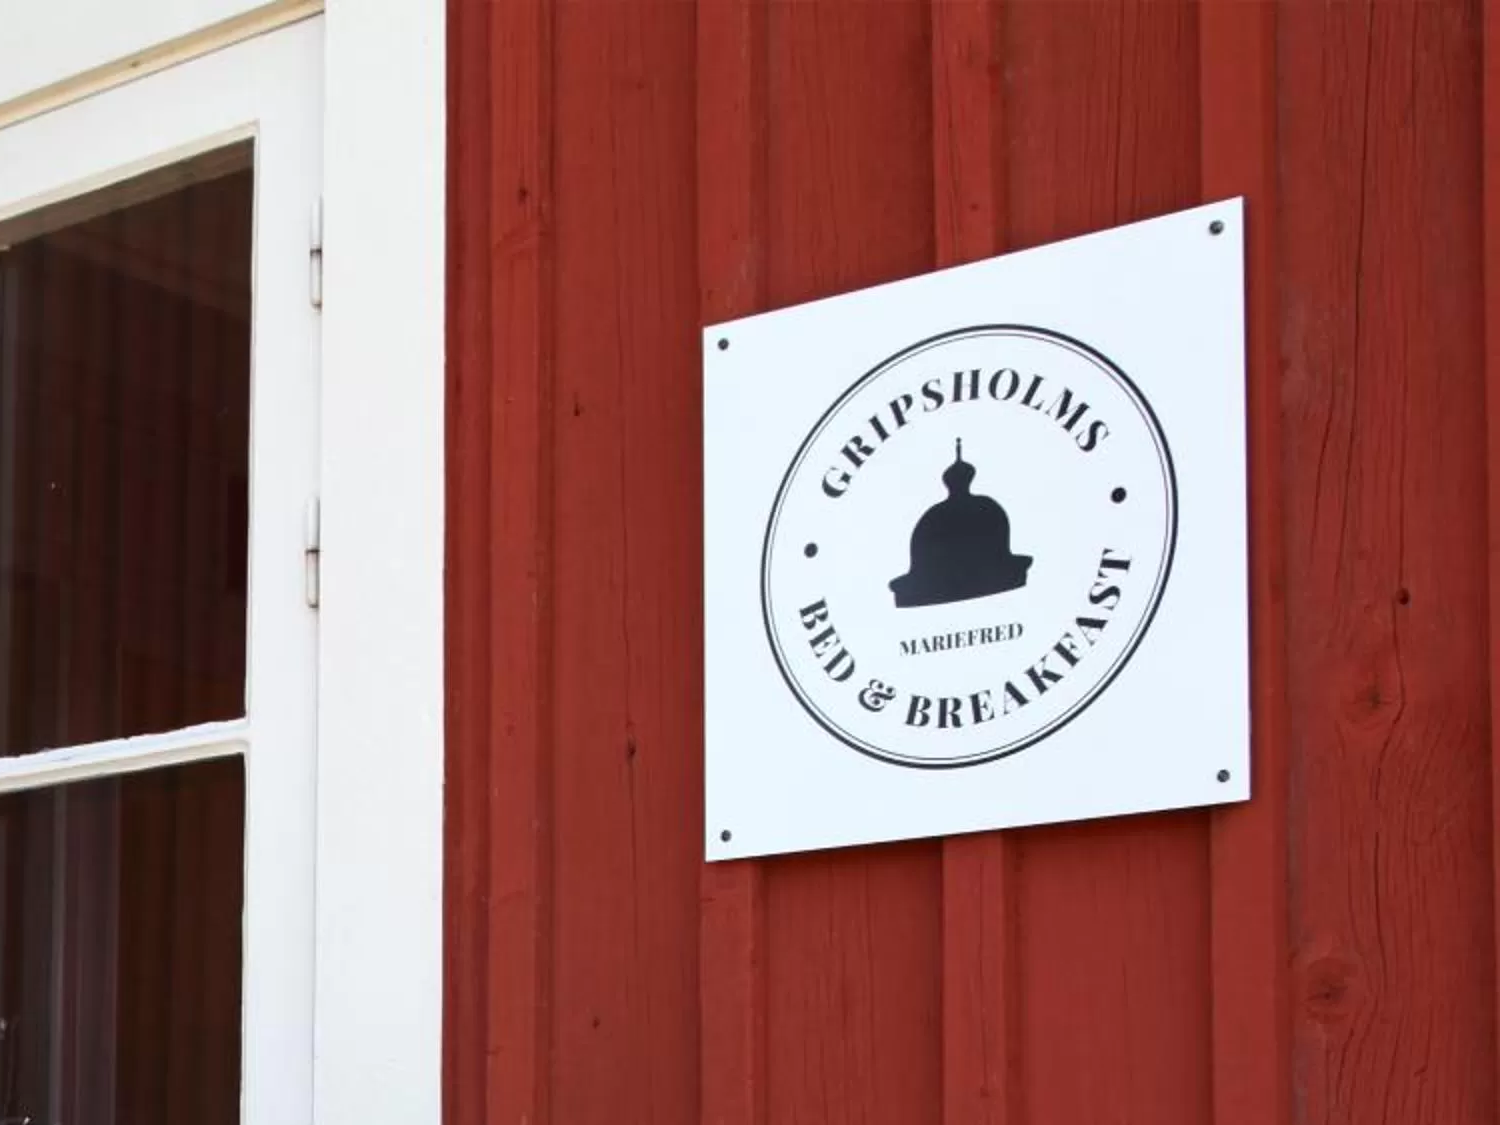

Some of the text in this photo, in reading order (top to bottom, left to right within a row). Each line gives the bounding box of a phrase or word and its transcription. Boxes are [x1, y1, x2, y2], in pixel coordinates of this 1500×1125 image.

[821, 367, 1111, 499] GRIPSHOLMS
[799, 548, 1132, 729] BED & BREAKFAST
[899, 621, 1025, 657] MARIEFRED
